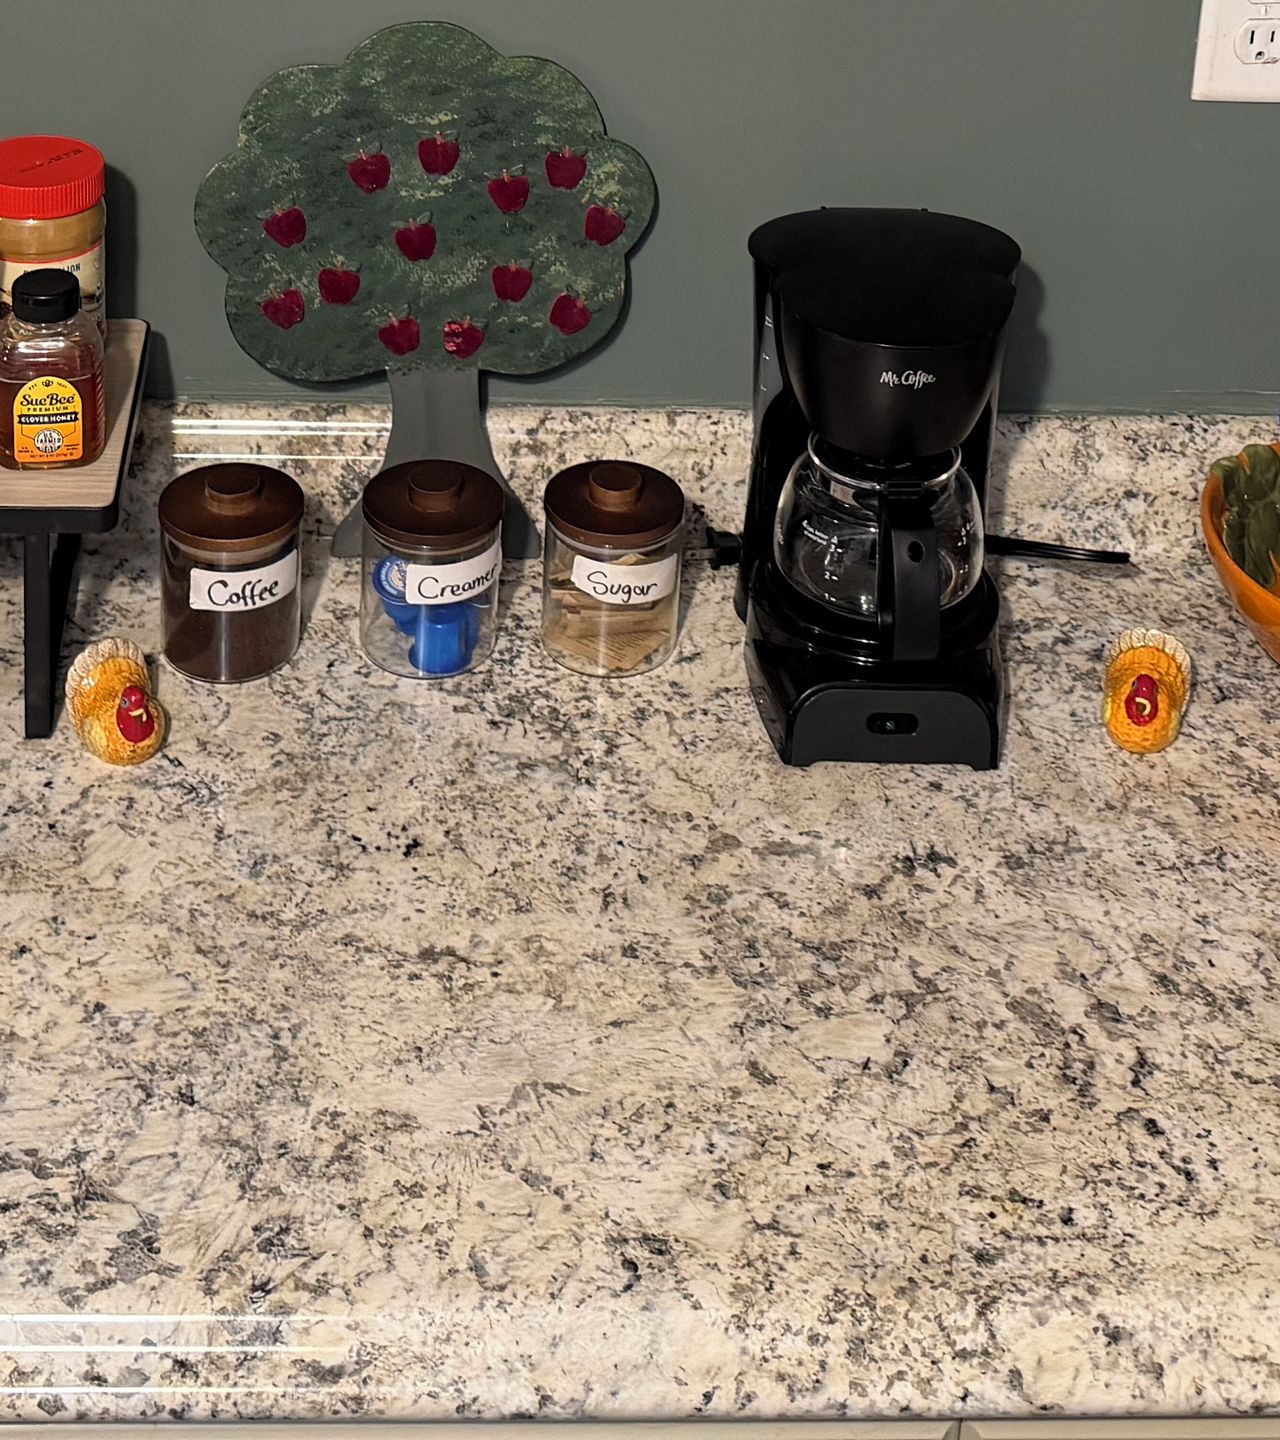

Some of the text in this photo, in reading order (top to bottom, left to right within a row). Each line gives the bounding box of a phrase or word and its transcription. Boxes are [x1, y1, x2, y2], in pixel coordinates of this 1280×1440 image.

[901, 370, 936, 390] Coffee
[27, 405, 69, 413] PREMIUM
[49, 414, 76, 422] HONEY
[417, 562, 498, 599] Creamer
[824, 571, 830, 580] 2
[207, 579, 280, 607] Coffee
[586, 570, 658, 603] Sugar
